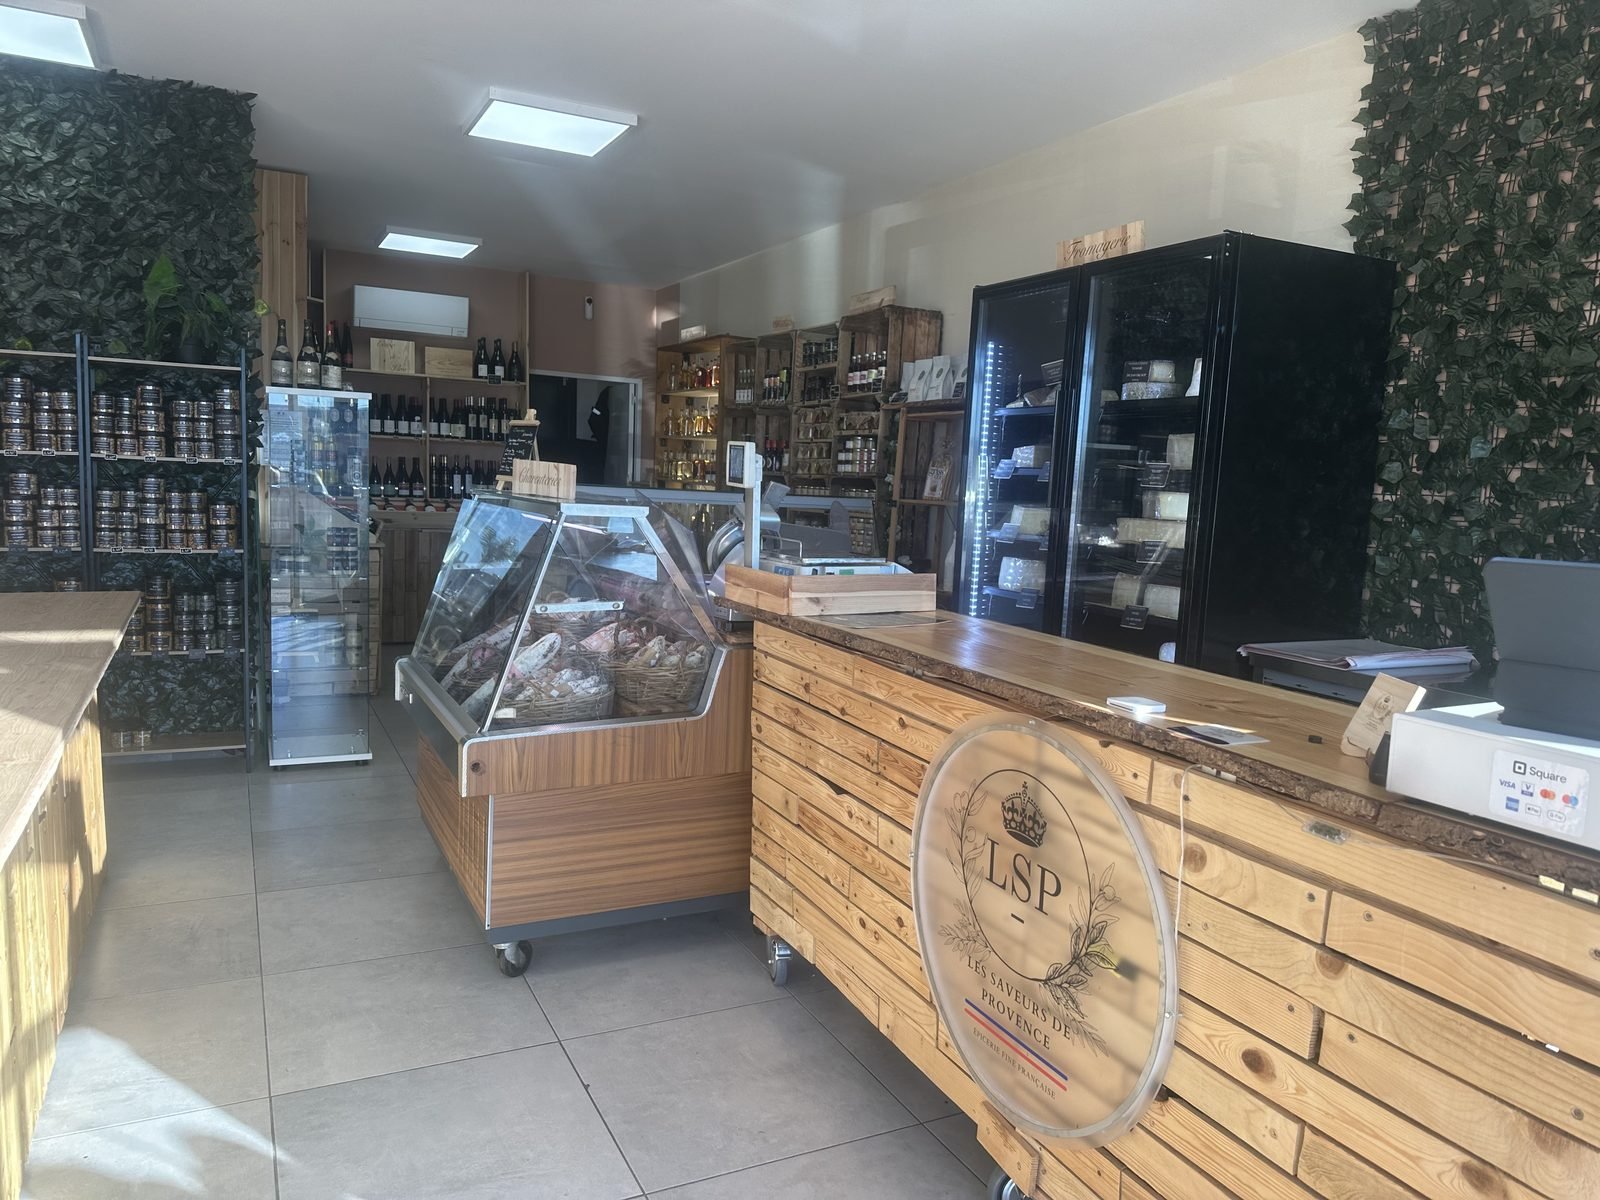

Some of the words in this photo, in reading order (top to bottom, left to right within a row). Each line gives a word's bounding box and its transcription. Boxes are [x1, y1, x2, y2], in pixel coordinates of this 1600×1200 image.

[1063, 231, 1131, 262] Fromagerie
[1499, 779, 1516, 790] VISA
[1529, 766, 1567, 784] Square
[985, 837, 1062, 916] LSP
[967, 956, 987, 978] LES
[990, 972, 1047, 1023] SAVEURS
[1052, 1016, 1071, 1040] DE
[981, 988, 1051, 1050] PROVENCE
[1001, 1051, 1017, 1068] FINE
[1017, 1062, 1056, 1100] FRANÇAISE
